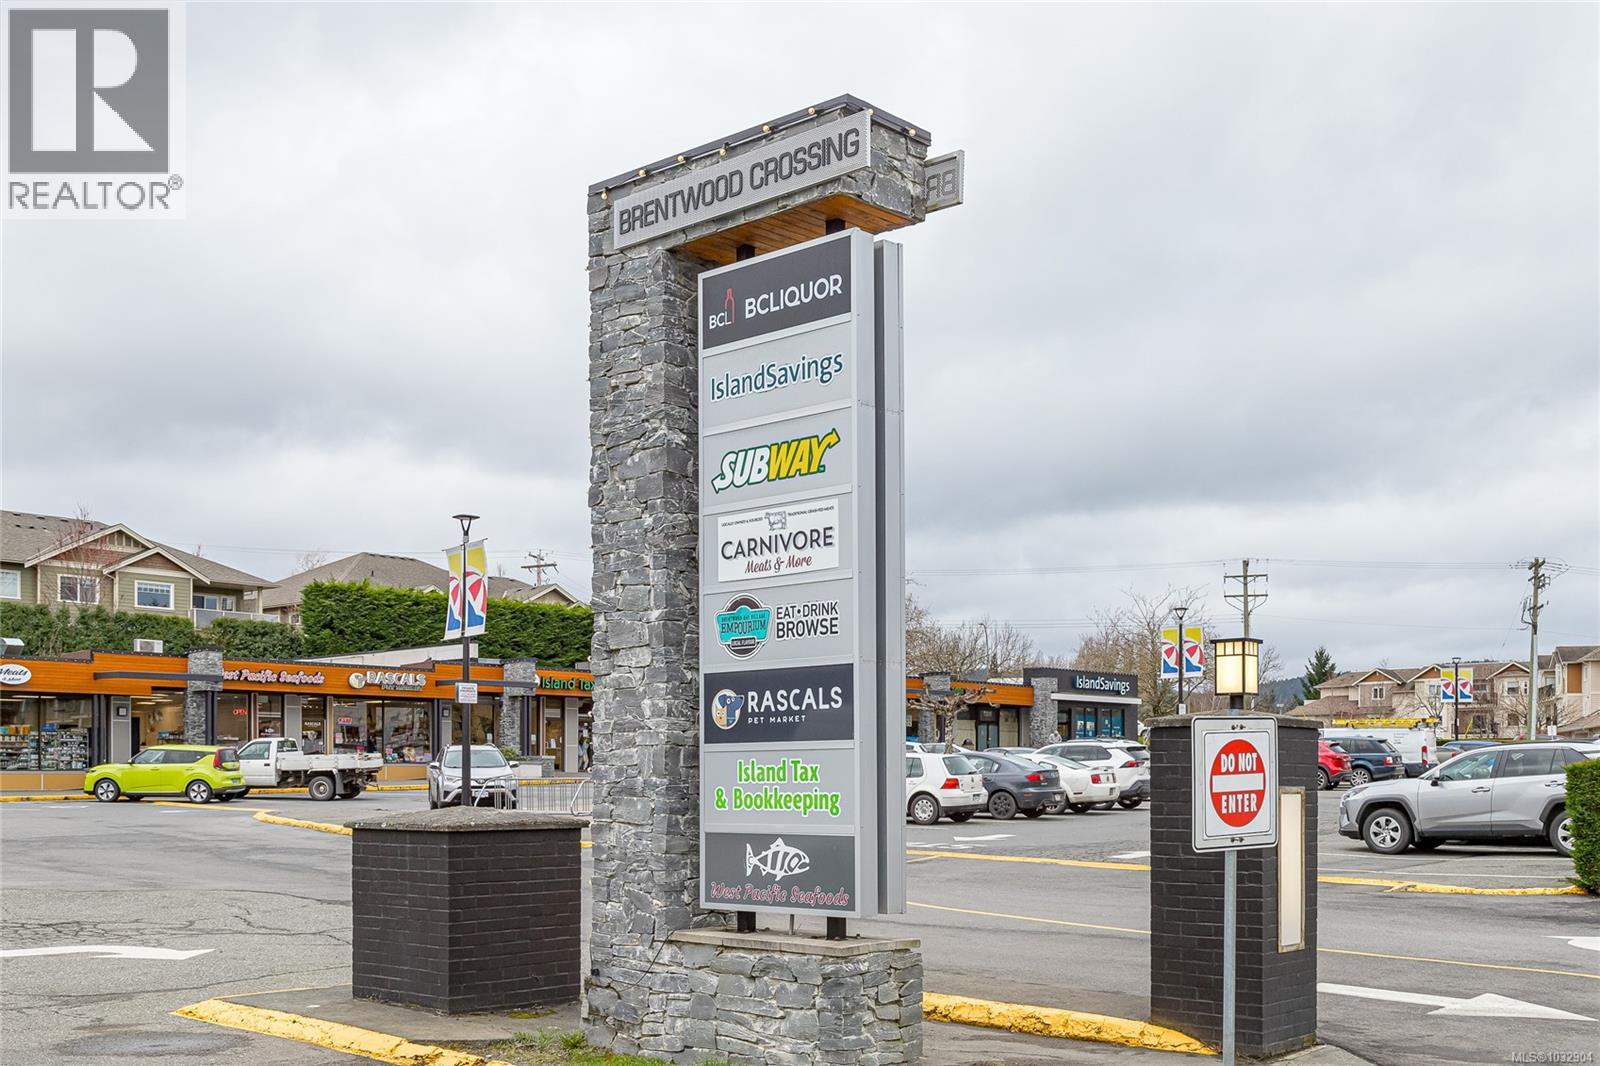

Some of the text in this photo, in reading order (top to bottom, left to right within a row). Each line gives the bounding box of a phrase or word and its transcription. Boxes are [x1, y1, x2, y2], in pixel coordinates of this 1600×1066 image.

[618, 127, 860, 236] BRENTWOOD CROSSING
[711, 353, 843, 400] IslandSavings
[711, 428, 841, 494] SUBWAY
[721, 526, 834, 560] CARNIVORE
[744, 554, 812, 574] Meats & More
[721, 619, 766, 635] EMPOURIUM
[776, 617, 839, 639] BROWSE
[221, 668, 326, 686] est Pacific Seafoods
[366, 670, 427, 687] RASCALS
[541, 676, 597, 690] Island Tax
[1075, 675, 1130, 695] IslandSavings
[747, 686, 843, 713] RASCALS
[769, 715, 806, 723] MARKET
[738, 758, 820, 783] Island Tax
[1221, 752, 1257, 773] DO NOT
[714, 786, 841, 817] & Bookkeeping
[1221, 793, 1258, 814] ENTER
[710, 881, 850, 907] West Pacific Seafoods
